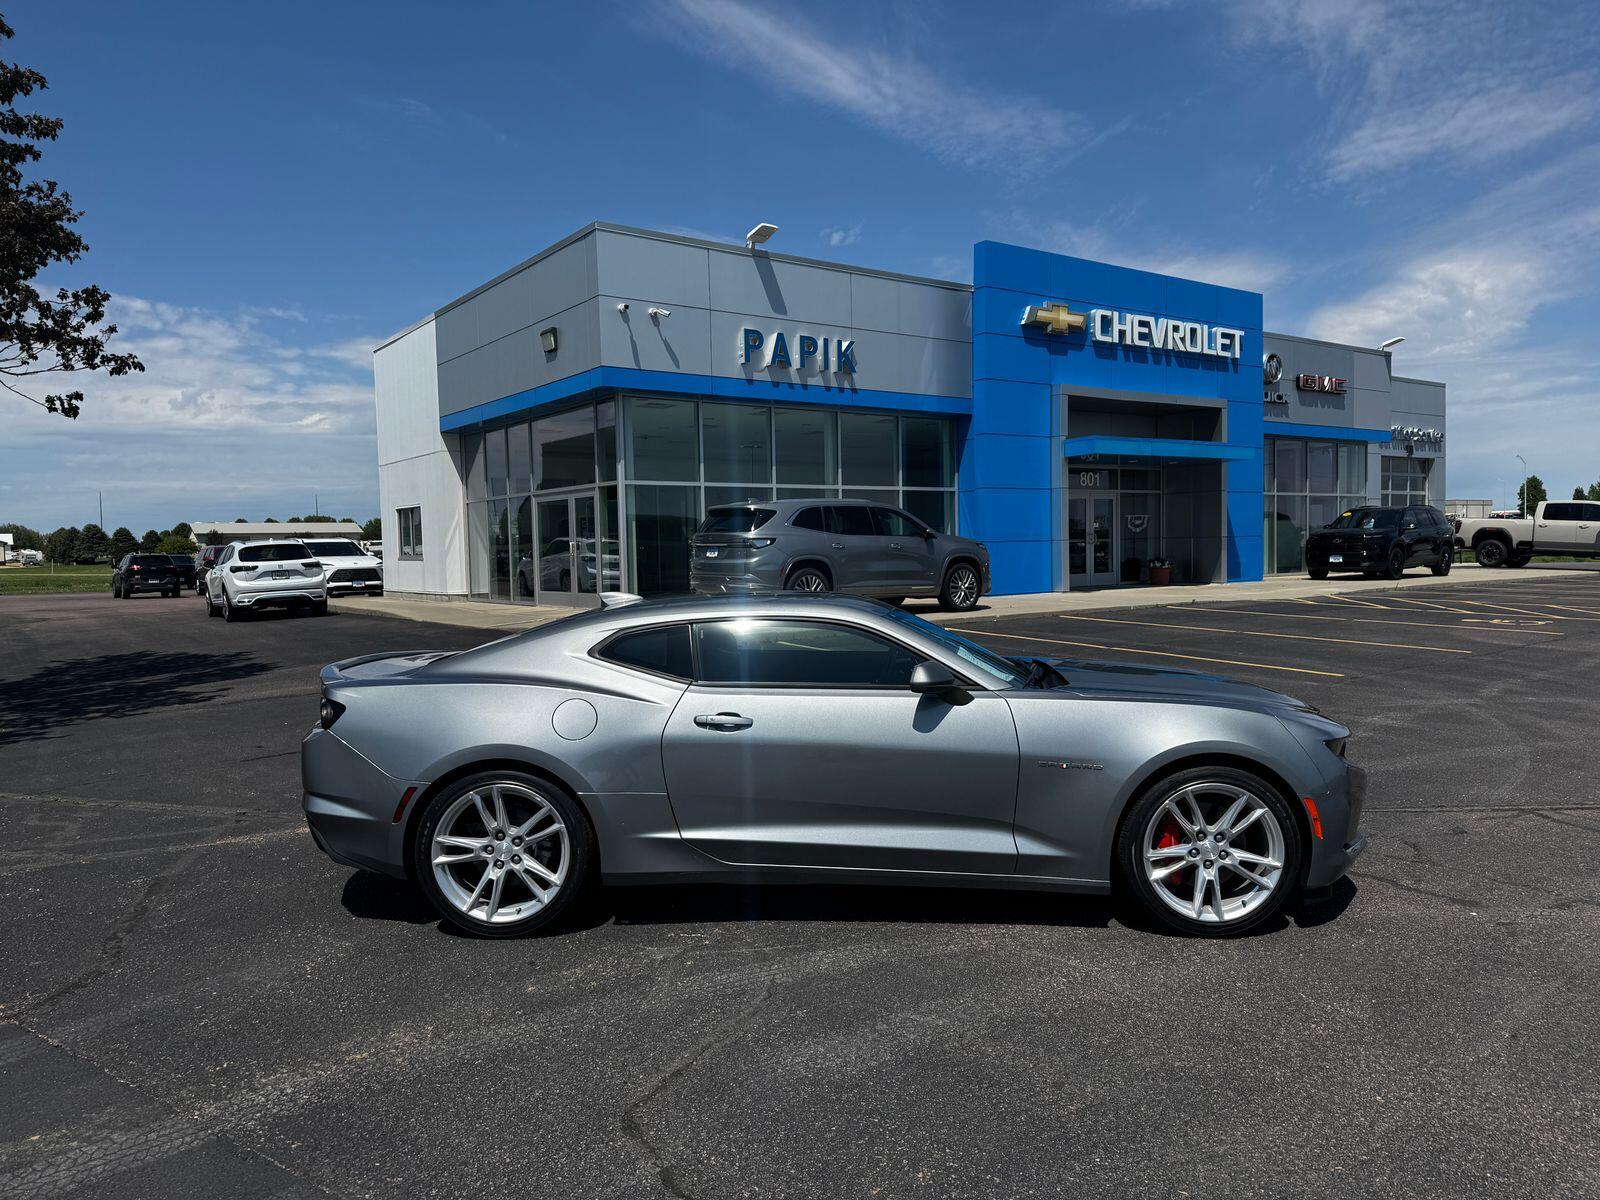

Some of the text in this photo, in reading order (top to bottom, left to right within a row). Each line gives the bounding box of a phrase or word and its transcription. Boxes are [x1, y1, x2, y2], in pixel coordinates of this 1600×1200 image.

[1091, 308, 1245, 359] CHEVROLET
[739, 327, 857, 373] PAPIK
[1297, 373, 1347, 394] GMC
[1264, 391, 1290, 404] UICK
[1080, 471, 1100, 487] 801
